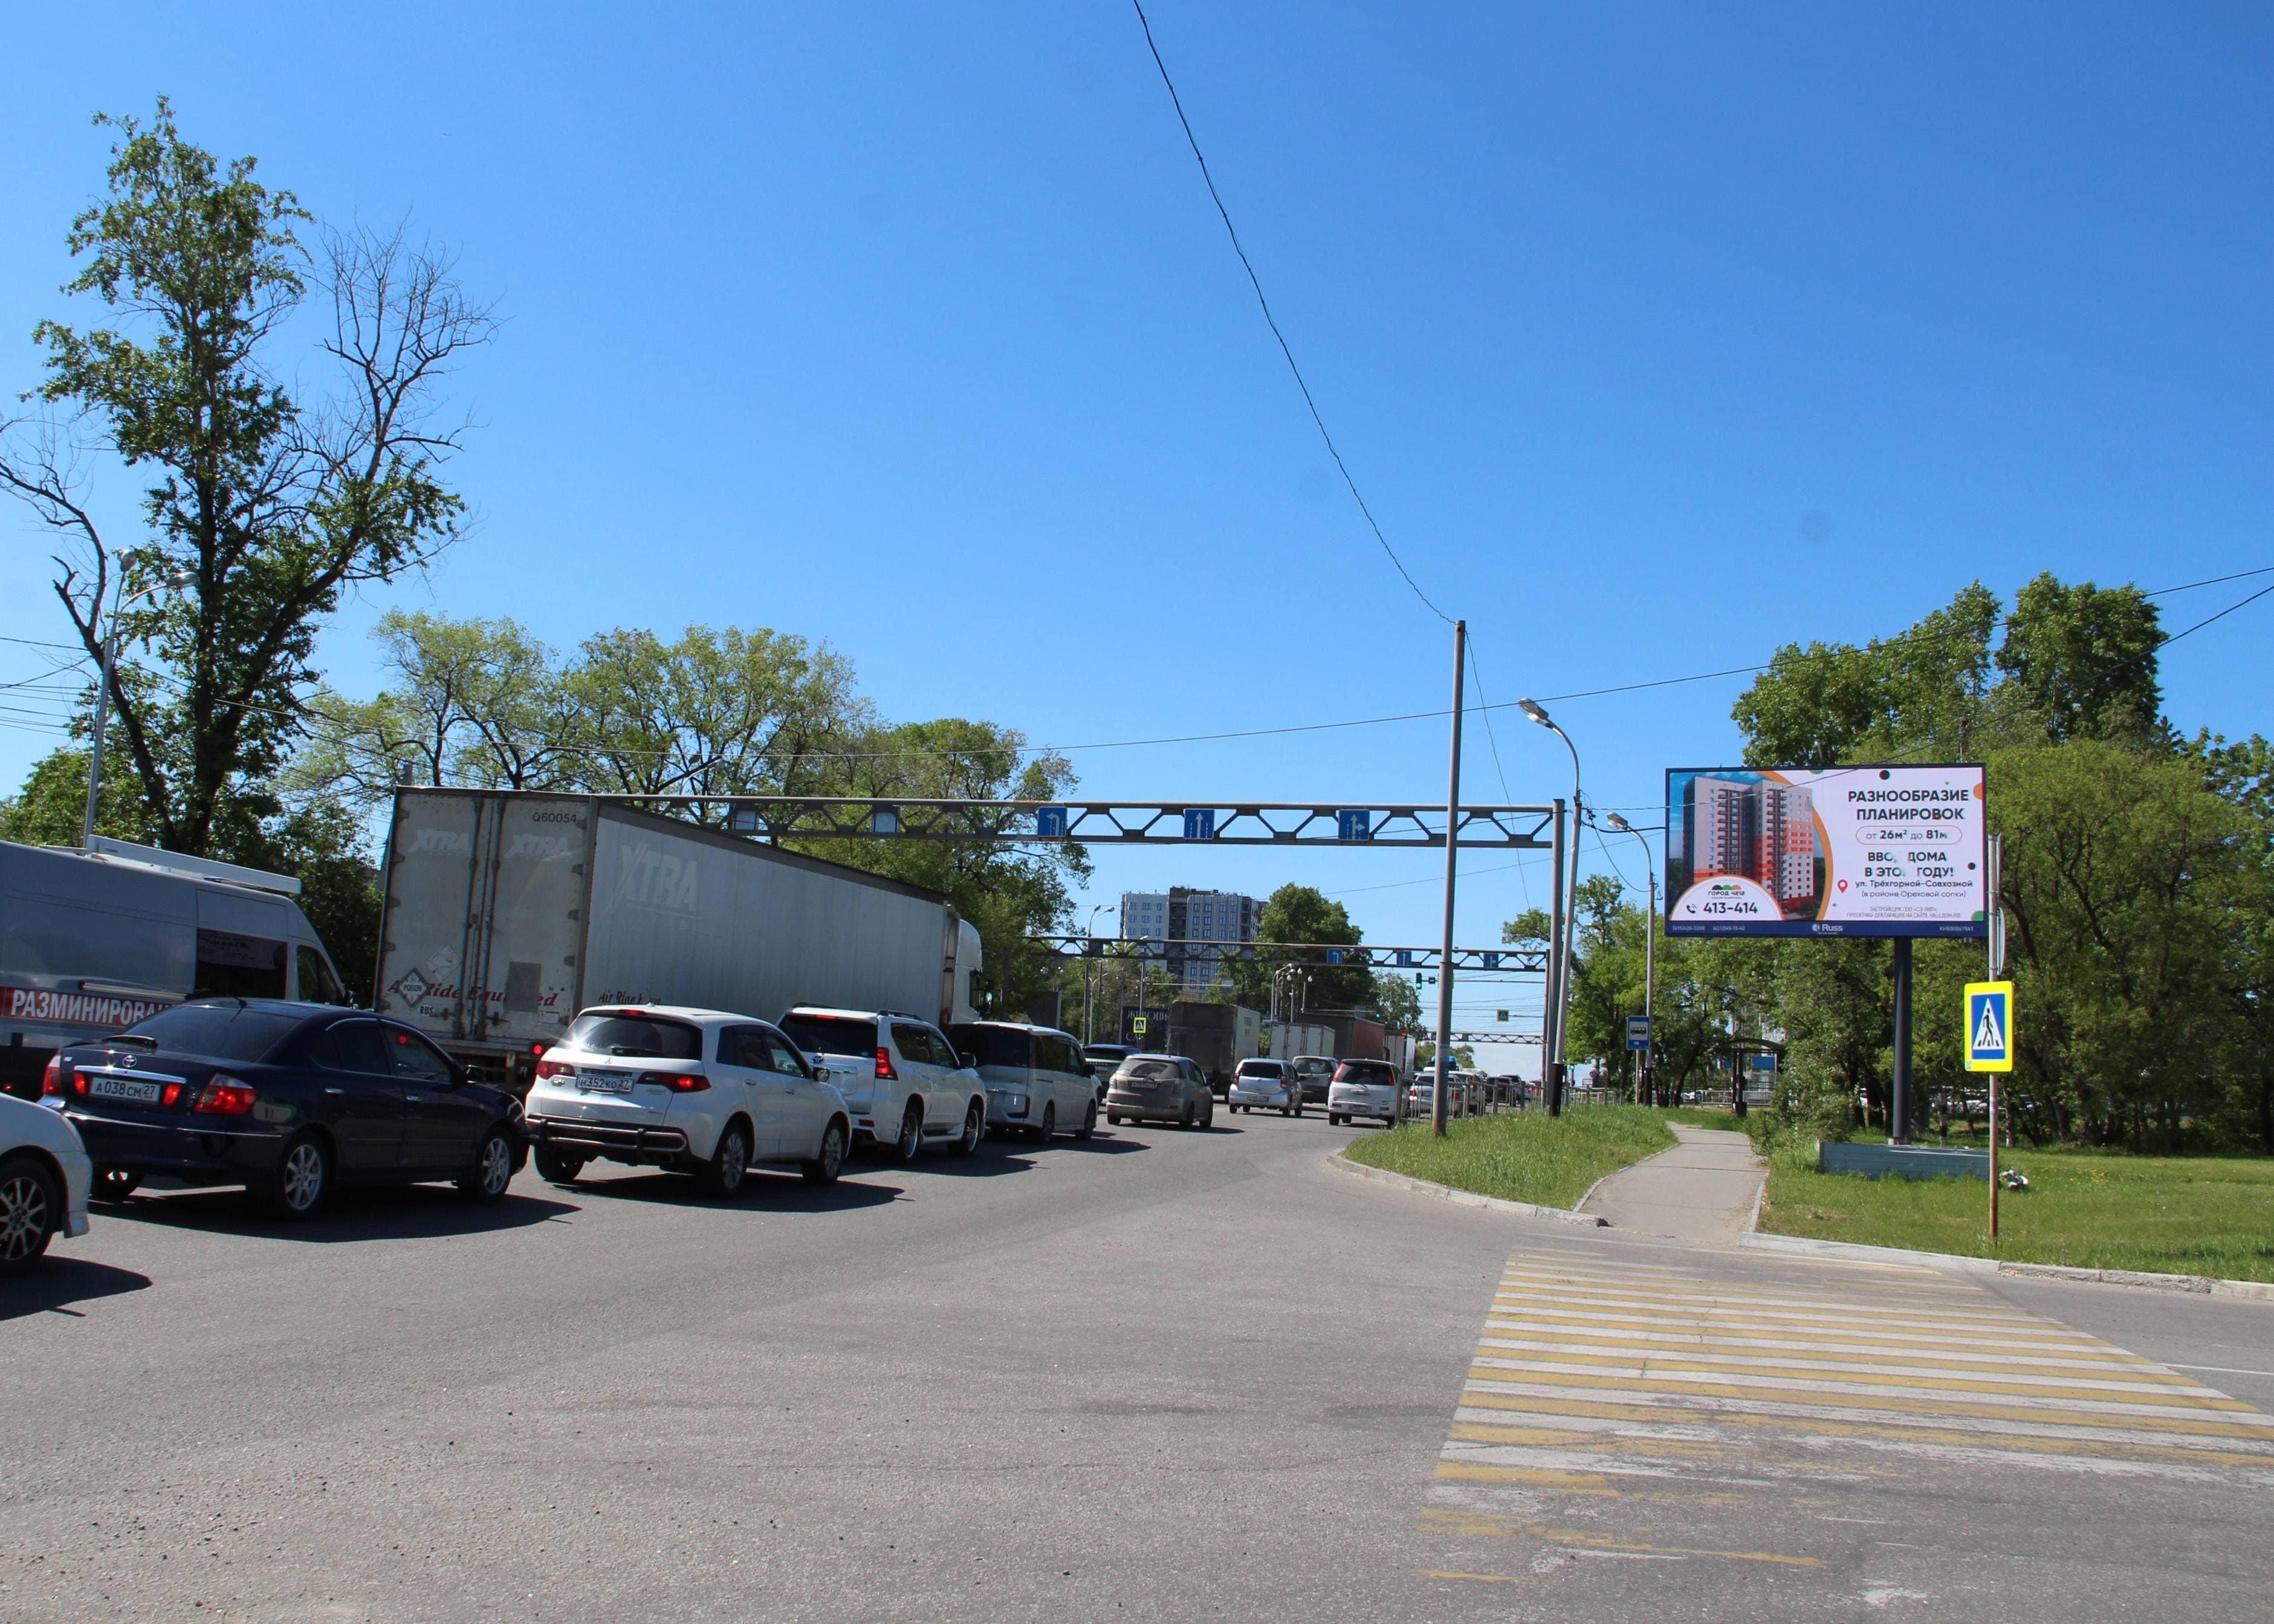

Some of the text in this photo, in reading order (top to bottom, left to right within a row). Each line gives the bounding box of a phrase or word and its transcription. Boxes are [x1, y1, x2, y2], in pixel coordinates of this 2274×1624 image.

[1848, 790, 1969, 803] РАЗНООБРАЗИЕ
[533, 812, 577, 823] Q60054
[1856, 808, 1965, 820] ПЛАНИРОВОК
[1868, 852, 1946, 863] ВВО ДОМА
[1865, 867, 1954, 878] В ЭТО ГОДУ!
[1703, 902, 1758, 914] 413-414
[10, 989, 173, 1026] РАЗМИНИРОВА
[420, 1006, 434, 1015] RUS
